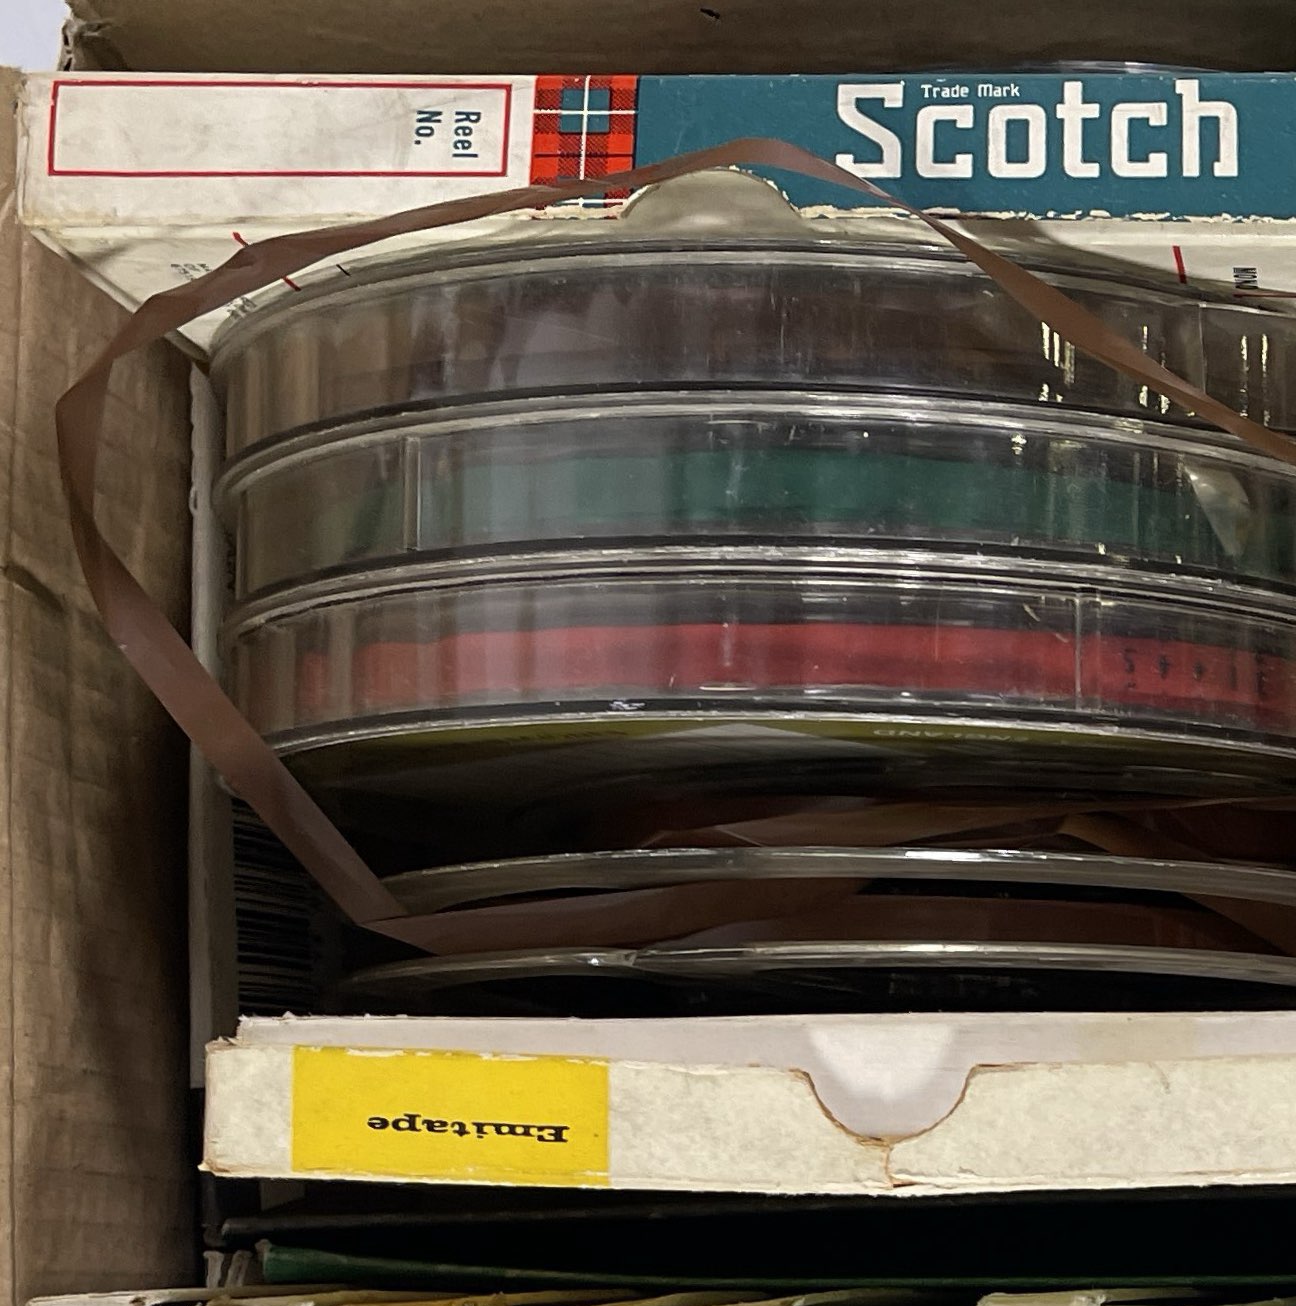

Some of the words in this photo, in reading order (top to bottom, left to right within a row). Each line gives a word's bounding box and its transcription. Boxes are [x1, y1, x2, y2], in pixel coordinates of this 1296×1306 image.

[921, 85, 969, 98] Trade
[978, 84, 1019, 97] Mark
[415, 110, 439, 144] No.
[453, 111, 481, 158] Reel
[836, 78, 1239, 180] Scotch
[368, 1114, 569, 1142] Emitape
